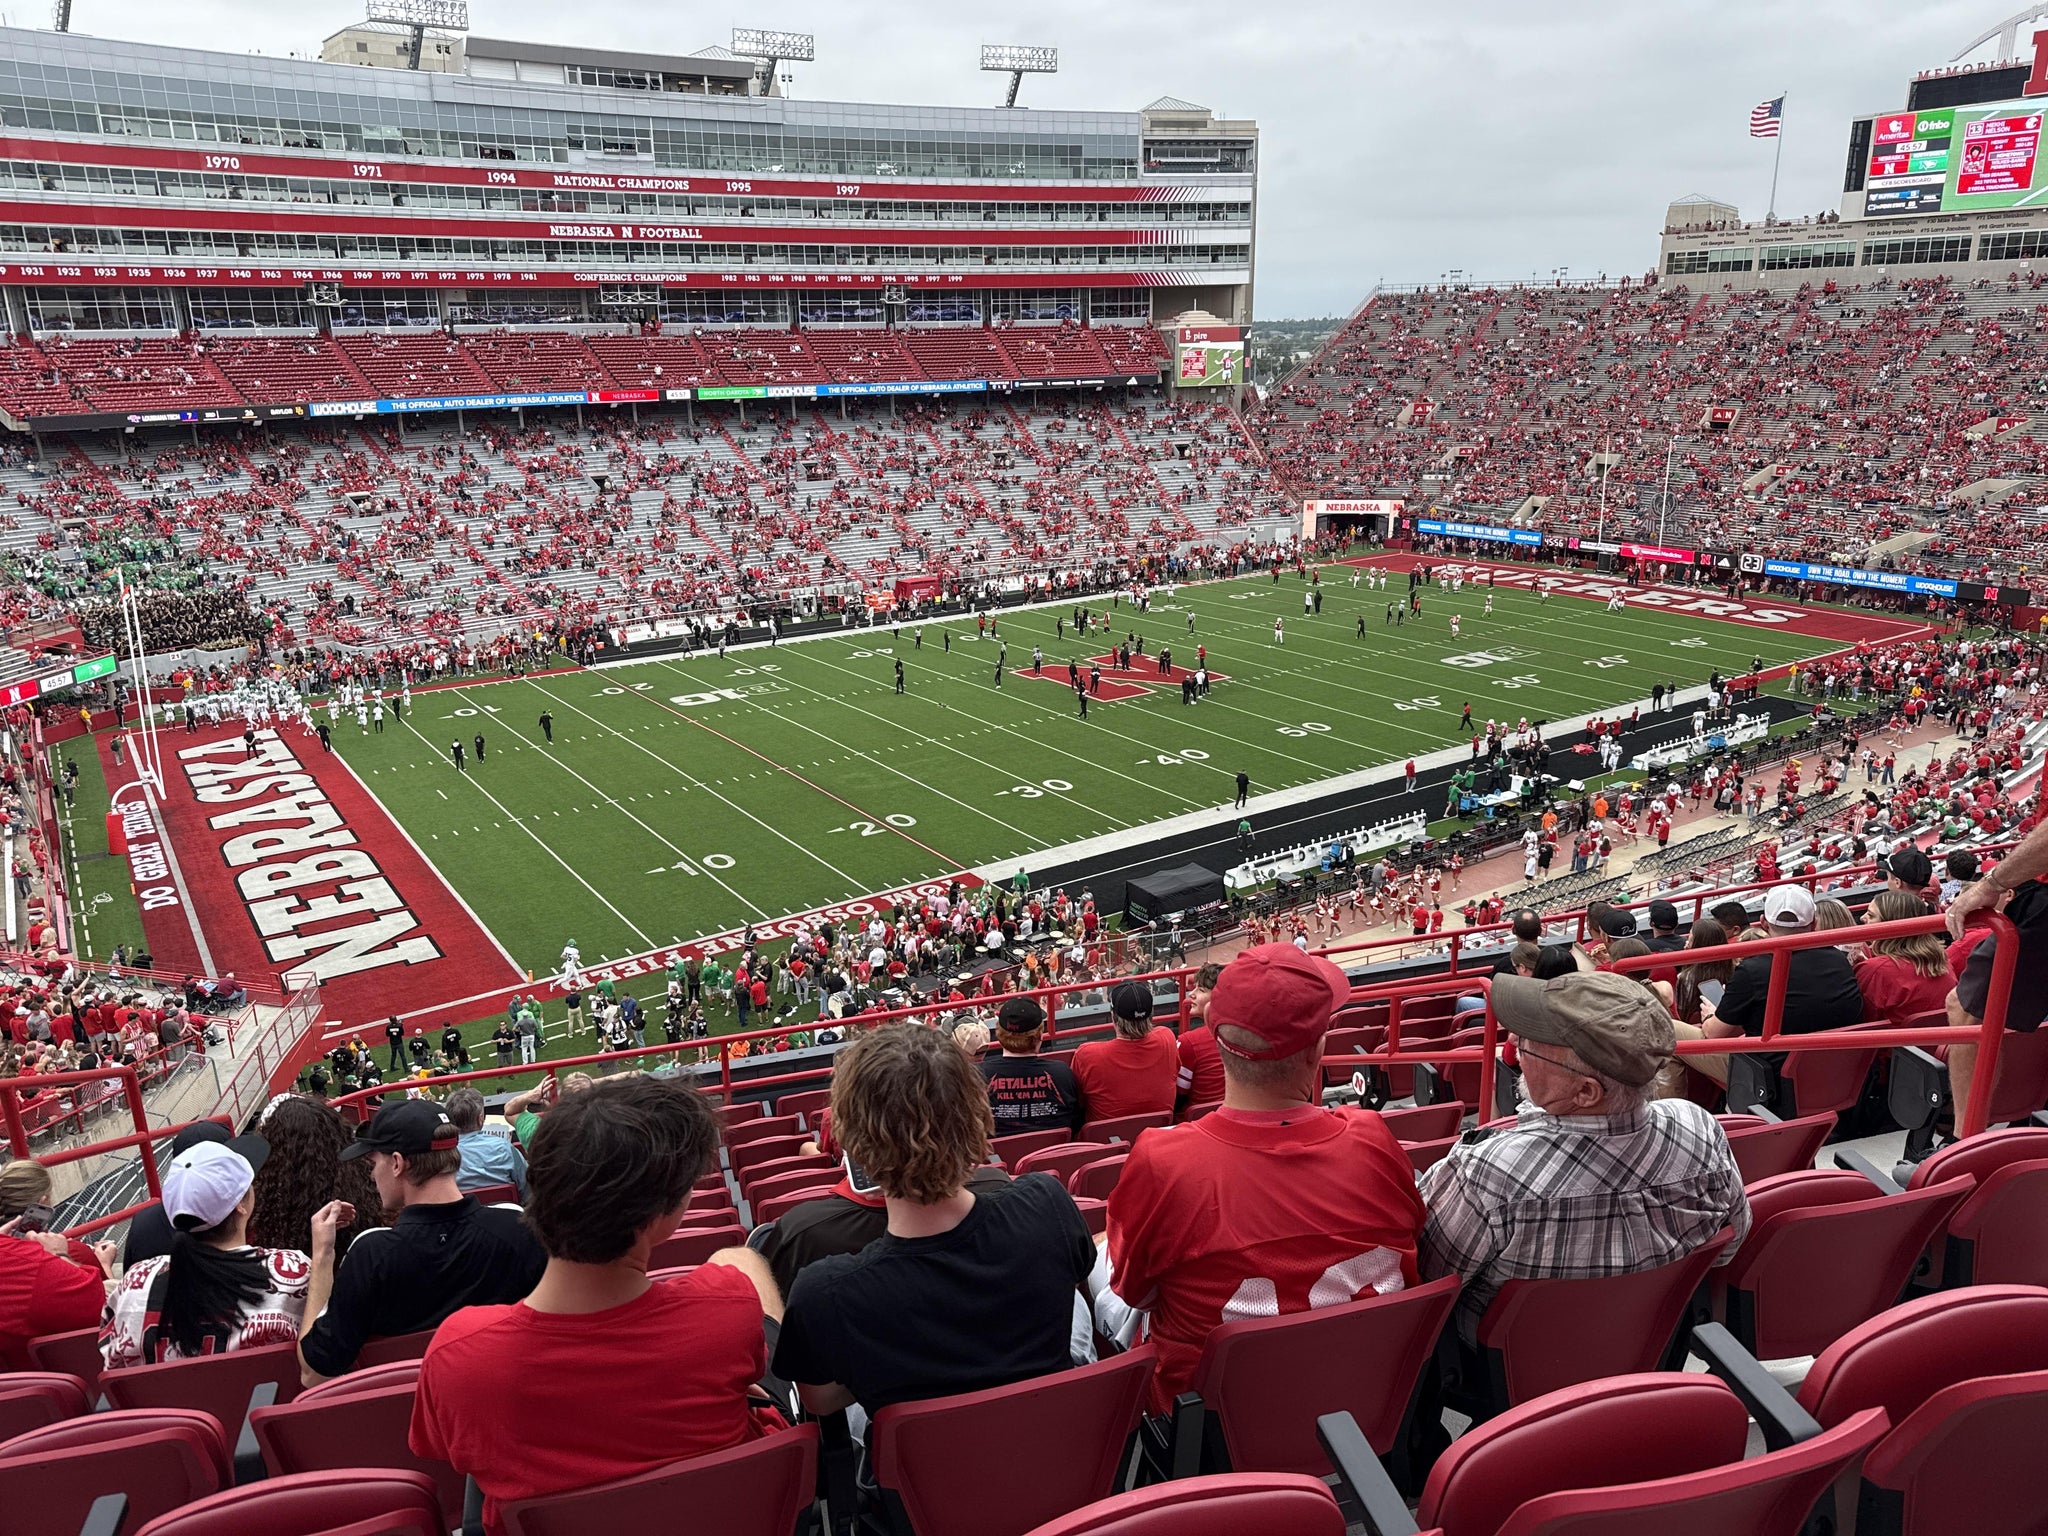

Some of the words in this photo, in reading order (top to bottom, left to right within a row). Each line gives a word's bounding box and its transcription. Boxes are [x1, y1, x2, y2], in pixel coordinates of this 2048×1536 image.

[1917, 57, 2020, 80] MEMORIAL
[1929, 120, 1950, 130] fnbo
[1878, 131, 1910, 140] Ameritas
[205, 156, 240, 170] 1970
[353, 164, 382, 178] 1971
[487, 172, 516, 184] 1994
[554, 175, 615, 188] NATIONAL
[618, 178, 690, 190] CHAMPIONS
[726, 182, 752, 192] 1995
[836, 185, 860, 196] 1997
[1884, 163, 1895, 174] N
[550, 226, 614, 237] NEBRASKA
[622, 226, 632, 238] N
[639, 227, 702, 238] FOOTBALL
[20, 266, 44, 276] 1931
[56, 267, 80, 276] 1932
[94, 268, 116, 277] 1933
[128, 268, 150, 277] 1935
[164, 268, 186, 278] 1936
[196, 269, 217, 278] 1937
[230, 270, 251, 278] 1940
[261, 270, 282, 278] 1963
[292, 270, 312, 279] 1964
[322, 270, 342, 279] 1966
[352, 271, 372, 280] 1969
[382, 272, 400, 280] 1970
[438, 272, 456, 280] 1972
[493, 272, 512, 280] 1978
[574, 273, 632, 282] CONFERENCE
[634, 274, 688, 282] CHAMPIONS
[592, 393, 600, 402] N
[768, 386, 817, 396] WOODHOUSE
[314, 402, 378, 414] WOODHOUSE
[409, 400, 442, 409] OFFICIAL
[444, 399, 464, 407] AUTO
[466, 398, 492, 406] DEALER
[508, 396, 546, 404] NEBRASKA
[548, 394, 584, 402] ATHLETICS
[1640, 519, 1684, 536] Allstate
[1568, 537, 1578, 549] N
[1701, 554, 1712, 564] N
[1744, 557, 1760, 570] 23
[1767, 564, 1801, 574] WOODHOUSE
[1808, 566, 1820, 574] OWN
[1822, 568, 1834, 576] THE
[1834, 569, 1851, 578] ROAD.
[1852, 572, 1866, 580] OWN
[1868, 573, 1880, 582] THE
[1880, 574, 1908, 585] MOMENT.
[1916, 581, 1953, 593] WOODHOUSE
[1984, 586, 1998, 600] N
[1008, 652, 1233, 702] N
[1490, 675, 1541, 689] 30
[10, 686, 22, 702] N
[1392, 696, 1442, 712] 40
[1276, 721, 1332, 738] 50
[1156, 748, 1210, 766] 40
[1010, 779, 1074, 798] 30
[850, 813, 917, 837] 20
[128, 842, 169, 881] GREAT
[175, 728, 446, 994] NEBRASKA
[672, 853, 736, 876] 10
[140, 886, 178, 910] DO
[695, 902, 876, 952] OSBORNE
[1354, 1074, 1364, 1092] N
[1032, 1090, 1047, 1099] ALL
[1931, 1093, 1938, 1102] 8
[281, 1259, 300, 1273] N
